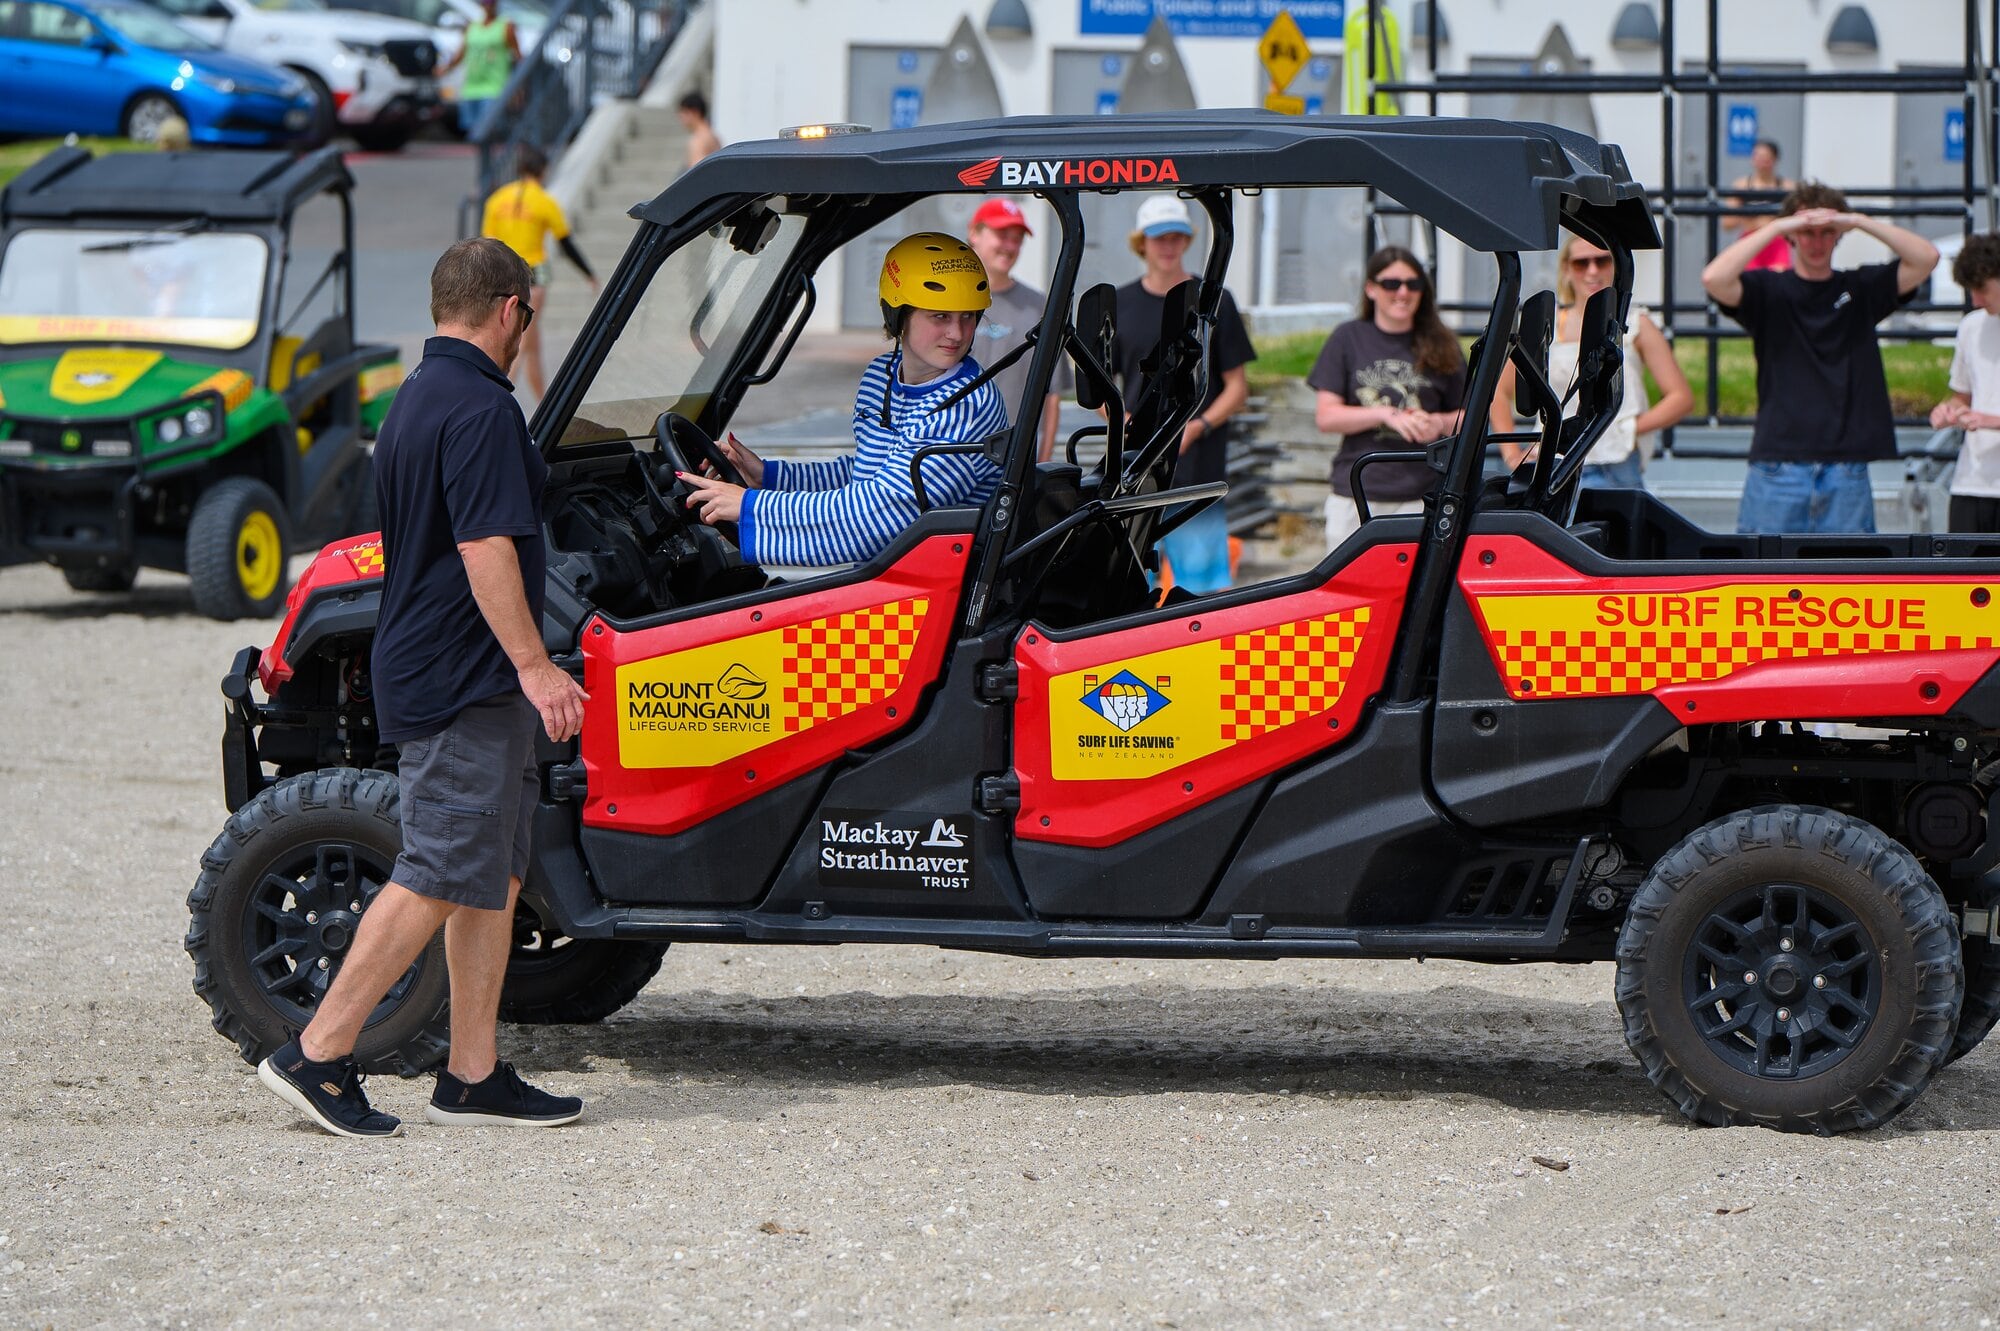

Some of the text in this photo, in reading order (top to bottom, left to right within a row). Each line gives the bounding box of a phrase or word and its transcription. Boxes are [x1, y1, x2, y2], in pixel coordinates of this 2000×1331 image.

[1216, 0, 1257, 17] and
[931, 258, 962, 267] MOUNT
[1596, 596, 1926, 630] SURF RESCUE
[629, 682, 714, 699] MOUNT
[629, 701, 770, 719] MAUNGANUI
[630, 722, 770, 732] LIFEGUARD SERVICE
[1078, 735, 1107, 749] SURF
[1109, 735, 1131, 749] LIFE
[1114, 752, 1175, 760] ZEALAND
[822, 820, 920, 851] Mackay
[821, 848, 969, 874] Strathnaver
[921, 876, 970, 889] TRUST
